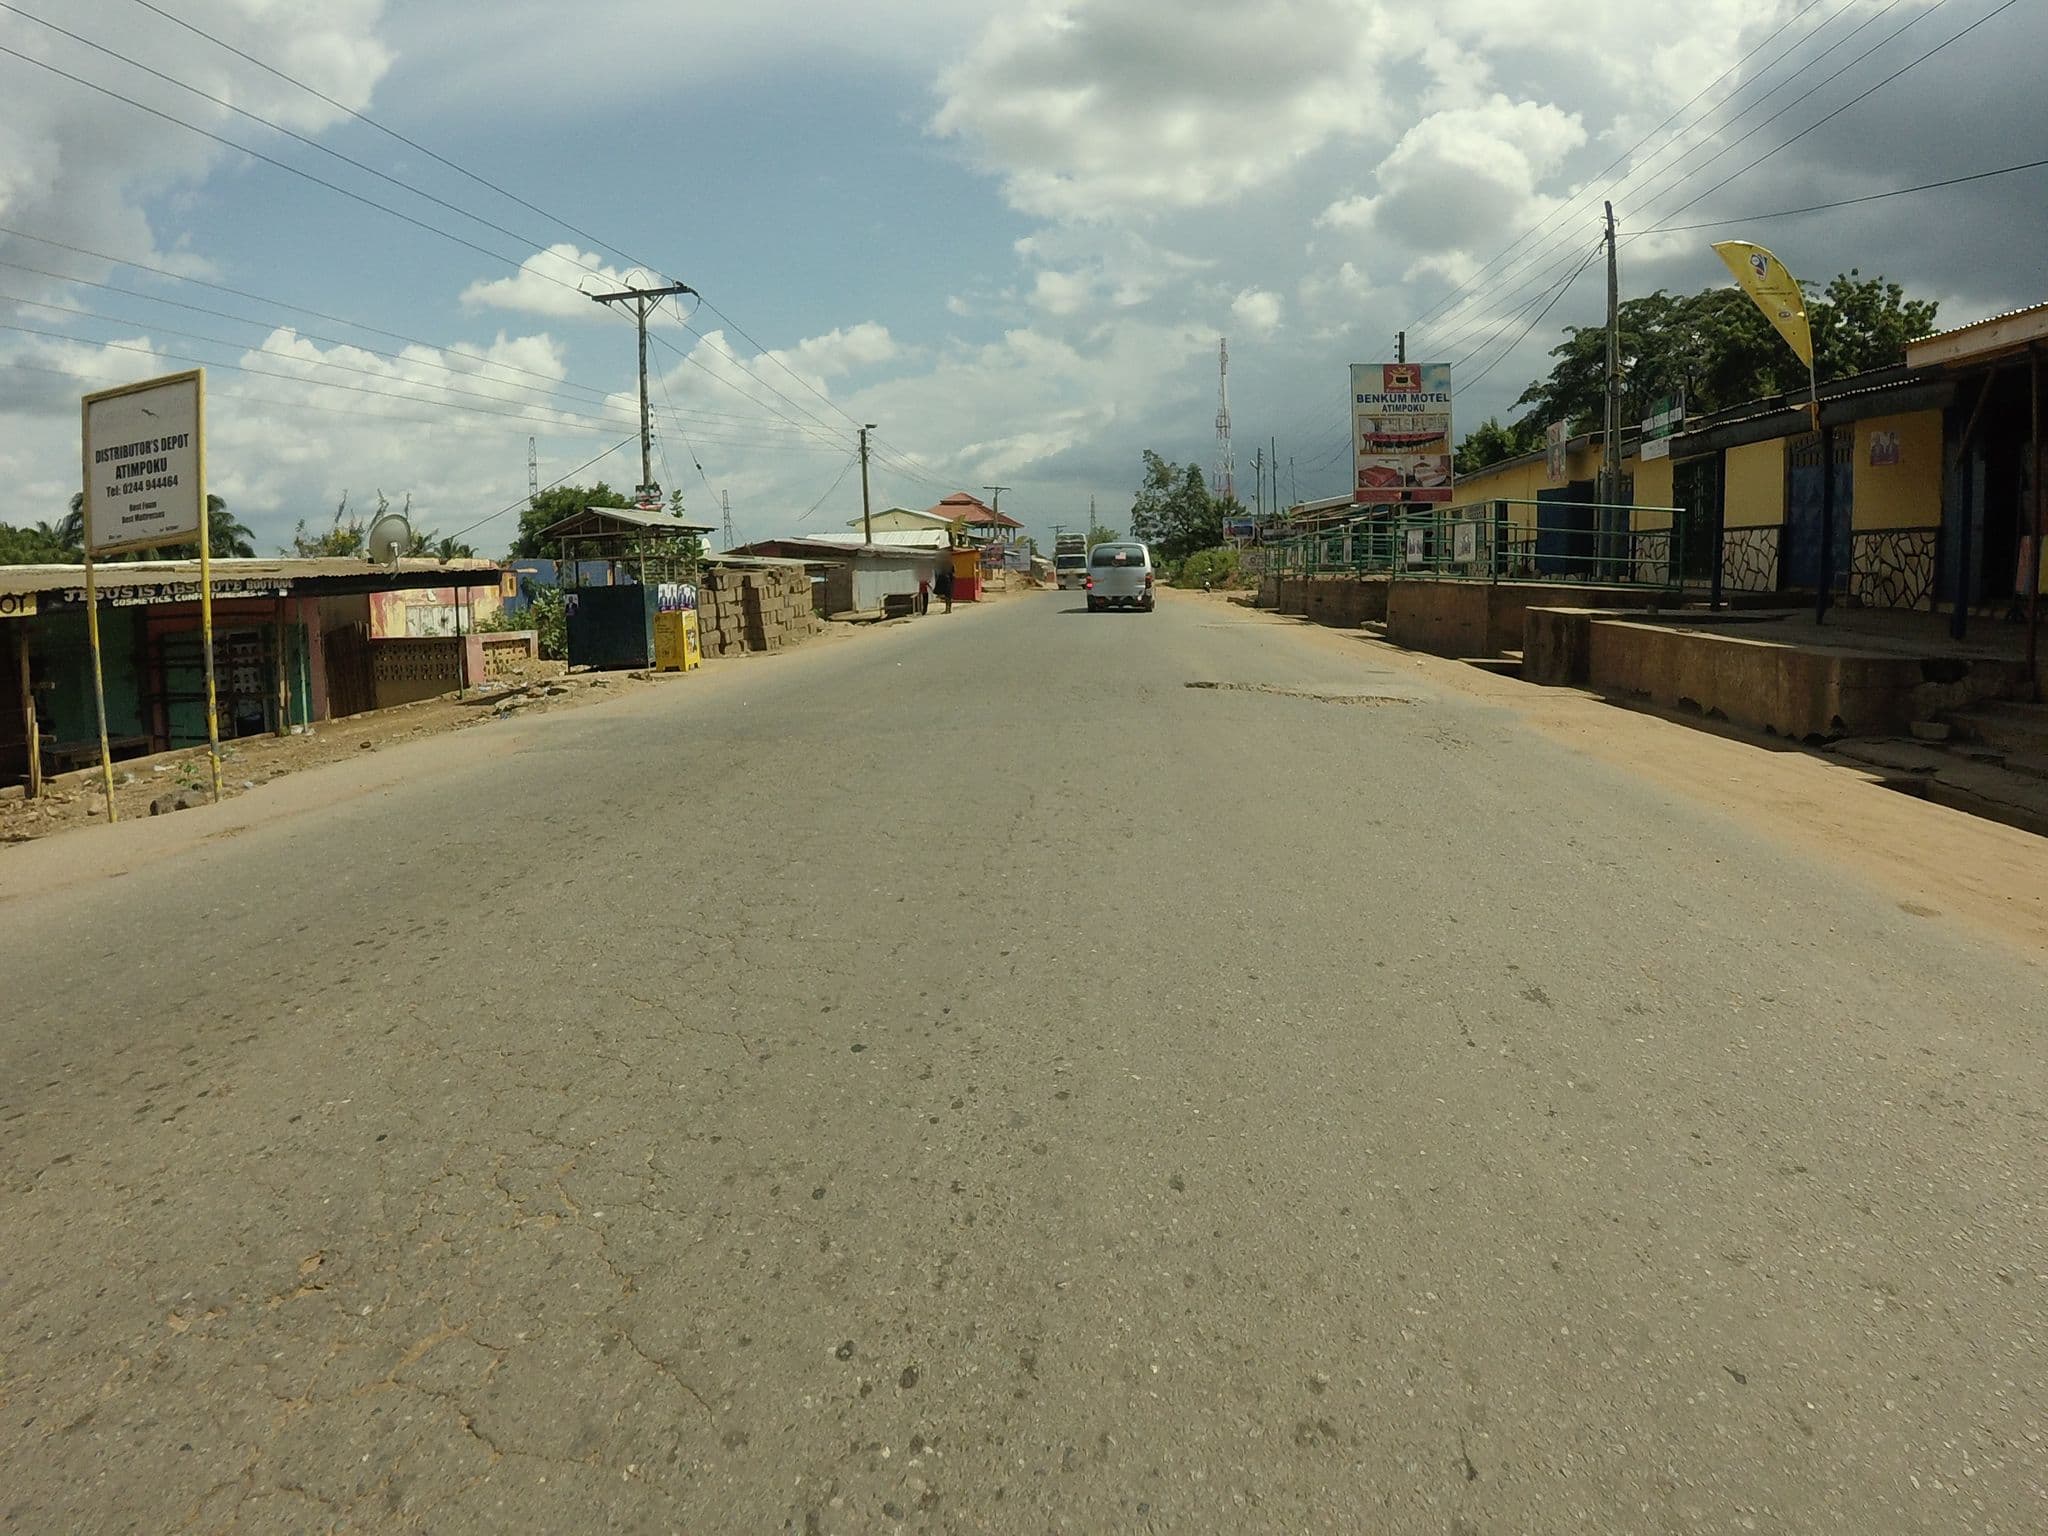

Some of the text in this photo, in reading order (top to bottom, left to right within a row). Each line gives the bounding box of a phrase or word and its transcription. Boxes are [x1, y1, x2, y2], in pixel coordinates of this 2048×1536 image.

[1356, 392, 1450, 403] BENKUM MOTEL
[1381, 404, 1425, 413] ATIMPOKU
[95, 433, 189, 463] DISTRIBUTOR'S DEPOT
[115, 457, 168, 480] ATIMPOKU
[122, 481, 144, 495] 0244
[138, 586, 156, 597] IS
[161, 580, 243, 595] ABSOUTE
